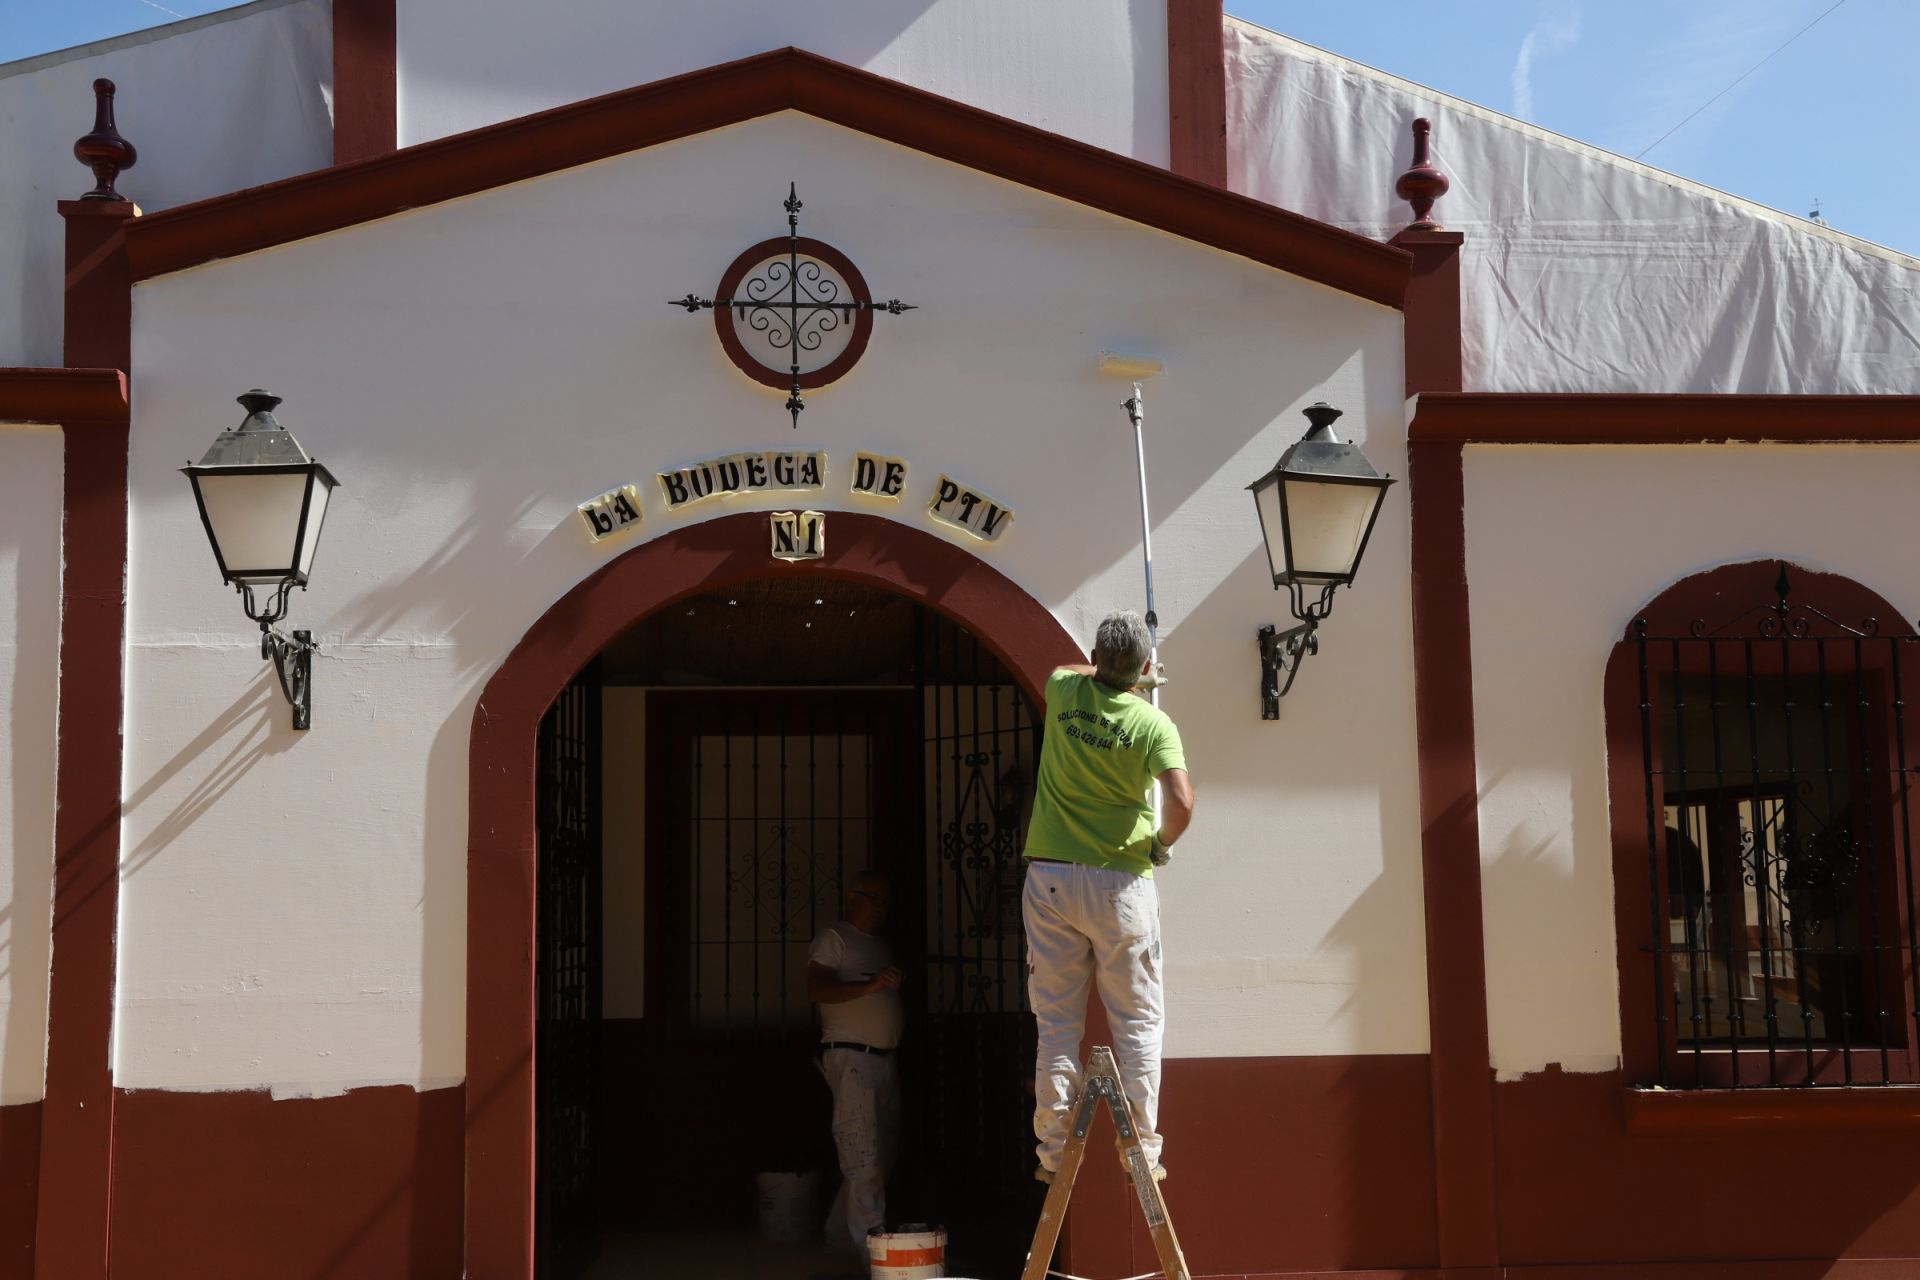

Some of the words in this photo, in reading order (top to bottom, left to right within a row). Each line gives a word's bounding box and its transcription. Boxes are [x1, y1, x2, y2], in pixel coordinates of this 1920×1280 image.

[585, 494, 639, 536] LA
[663, 456, 821, 505] BODEGA
[854, 457, 904, 495] DE
[934, 479, 1009, 536] PTV
[1099, 717, 1111, 728] DE
